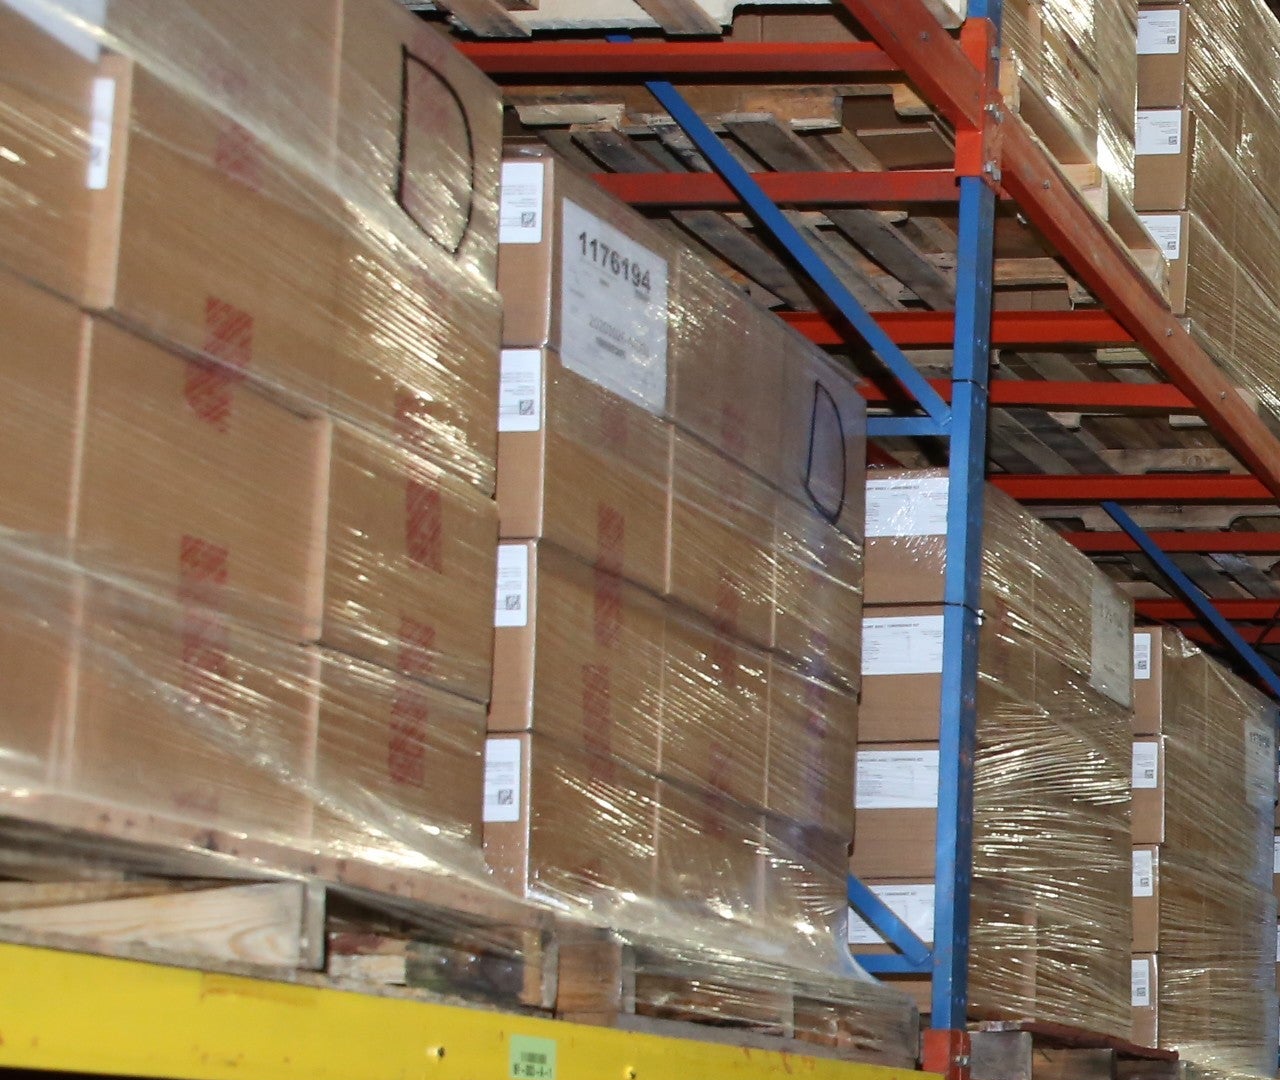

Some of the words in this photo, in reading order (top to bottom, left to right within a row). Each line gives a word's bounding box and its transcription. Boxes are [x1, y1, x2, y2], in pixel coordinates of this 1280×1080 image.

[397, 43, 476, 258] D
[578, 230, 652, 293] 1176194
[805, 379, 846, 523] D
